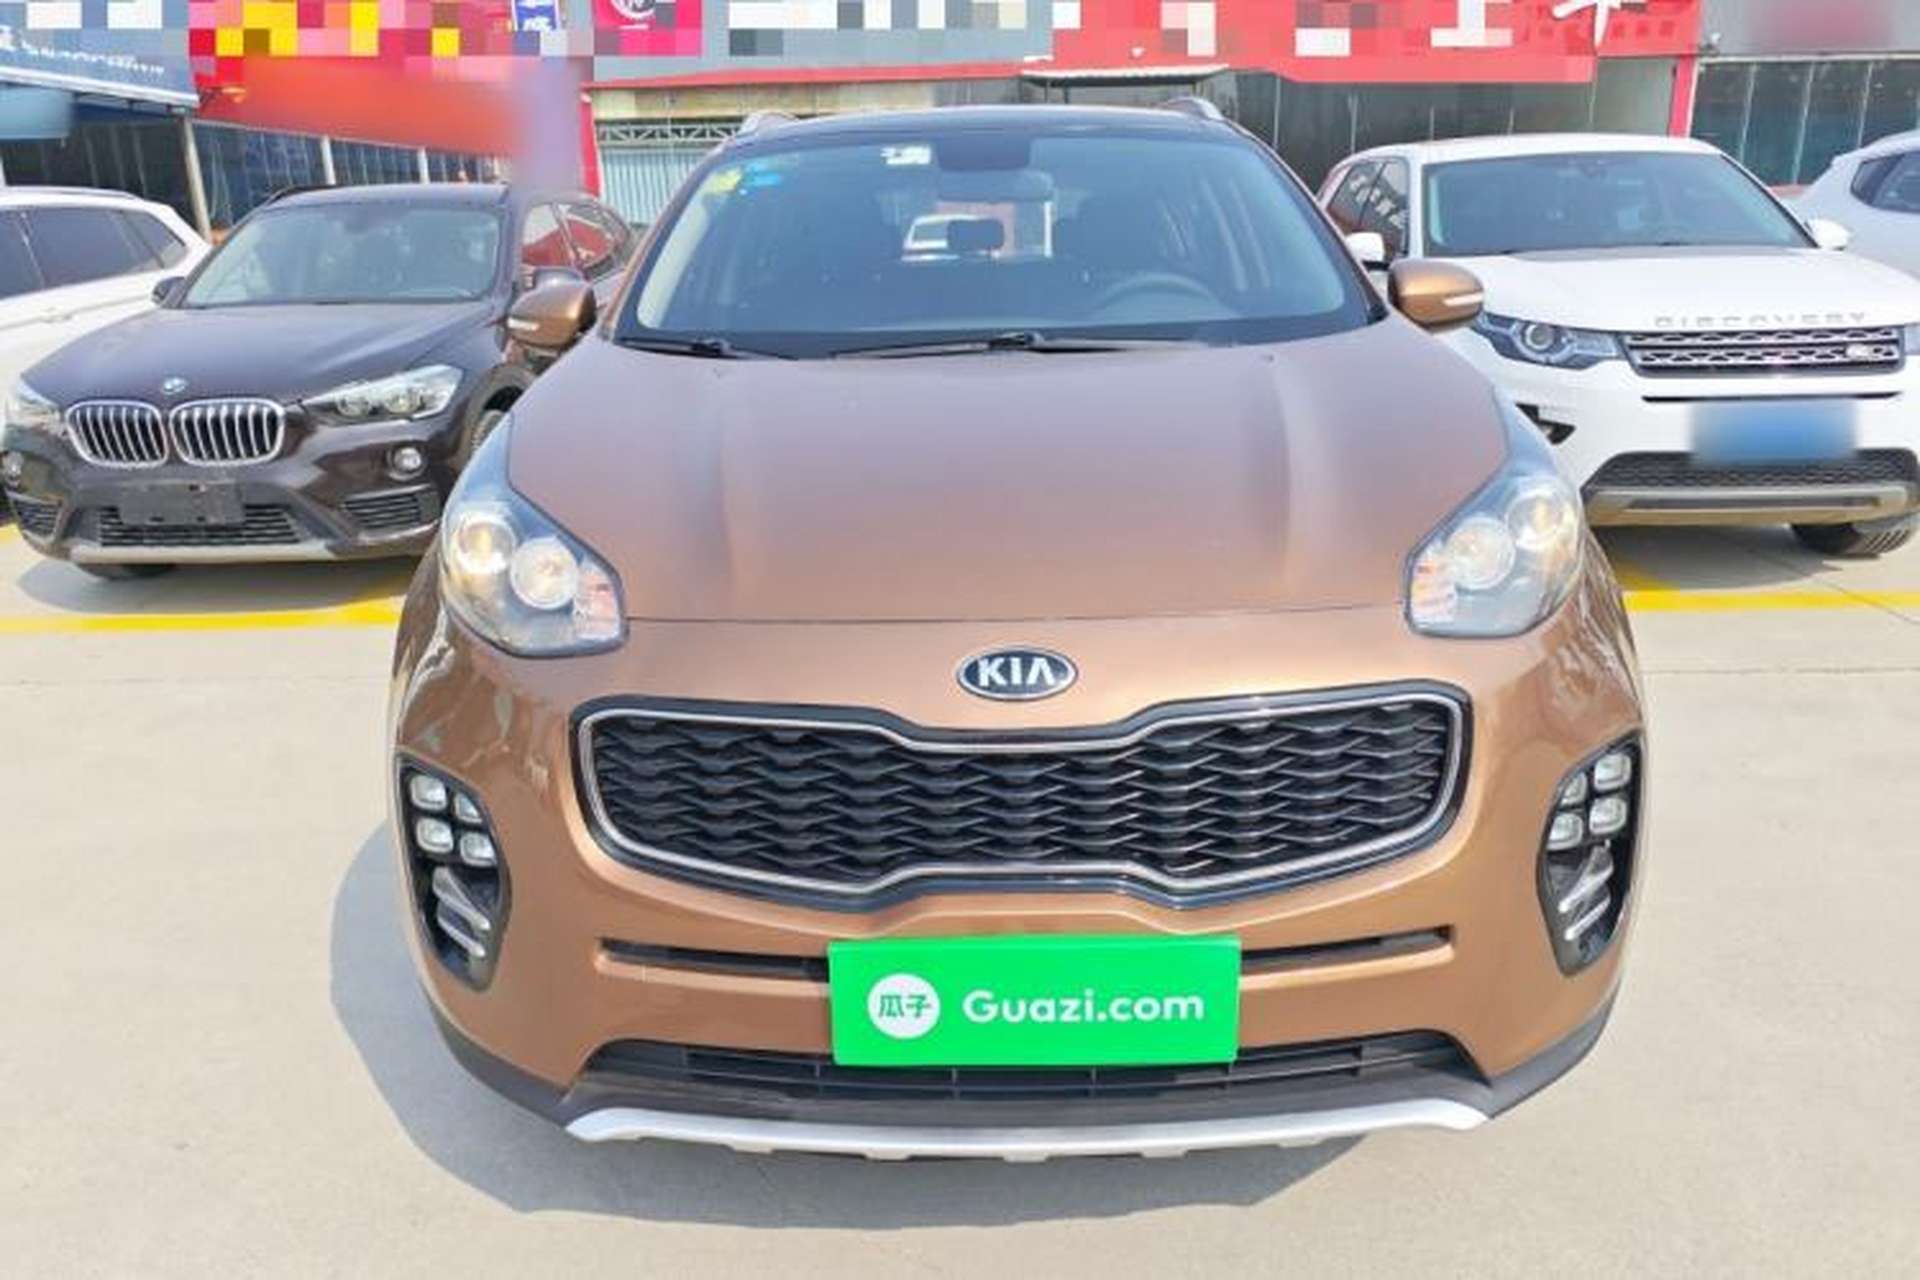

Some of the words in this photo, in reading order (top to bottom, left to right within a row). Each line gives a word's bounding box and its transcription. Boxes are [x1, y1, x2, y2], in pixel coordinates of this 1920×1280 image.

[1654, 311, 1865, 329] DISCOVERY
[977, 656, 1056, 687] KIA
[878, 993, 933, 1019] 瓜子
[962, 987, 1205, 1024] Guazi.com
